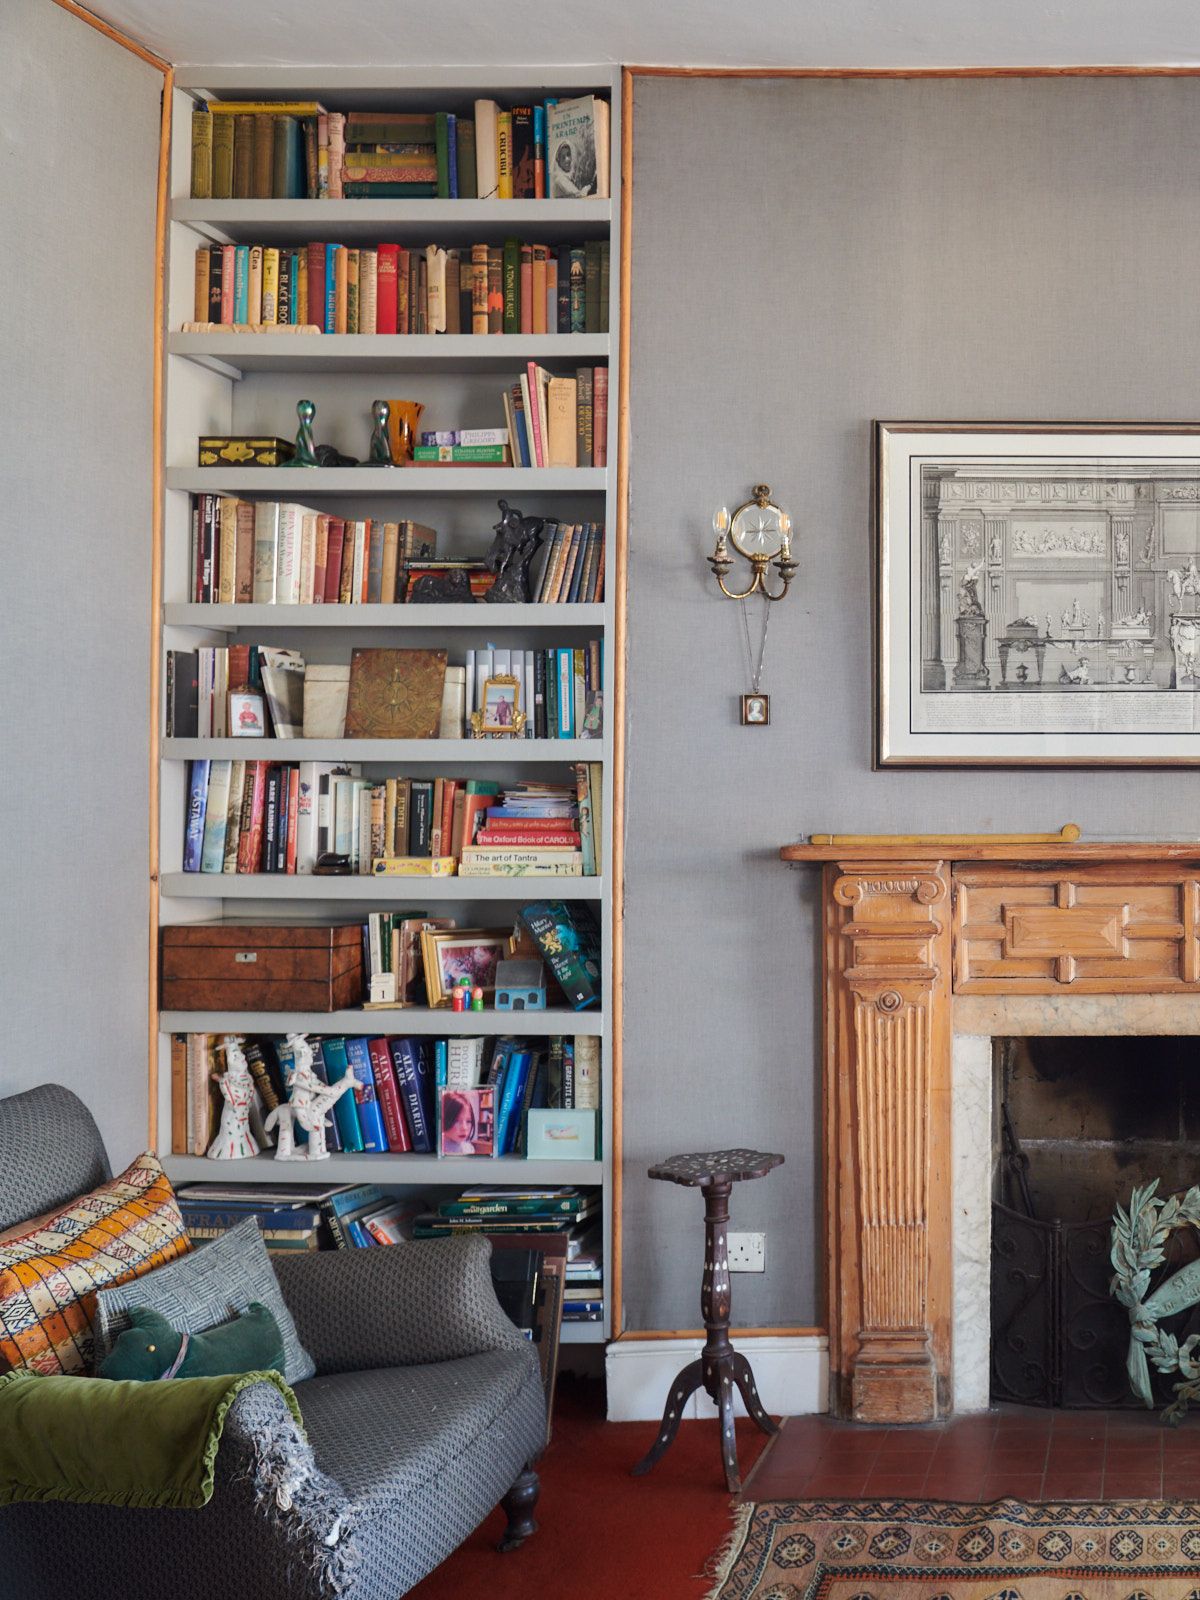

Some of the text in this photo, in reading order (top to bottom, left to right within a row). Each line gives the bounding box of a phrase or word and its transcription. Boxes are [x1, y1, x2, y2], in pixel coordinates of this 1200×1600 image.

[552, 115, 593, 131] PRINTEMPS
[499, 131, 508, 177] CRUCIBLE
[252, 249, 261, 271] Clea
[505, 270, 514, 290] TOWN
[279, 275, 288, 308] BLACK
[505, 291, 514, 303] LIKE
[279, 306, 288, 326] BOO
[505, 303, 514, 319] ALICE
[464, 431, 497, 439] PHILIPPA
[286, 510, 296, 551] RONALD
[189, 787, 202, 841] CASTAWAY
[266, 780, 276, 842] DARK RAINBOW
[397, 796, 406, 828] JUDITH
[480, 835, 574, 845] The Oxford Book of CAROLS
[475, 853, 538, 862] The art of Tantra
[422, 922, 437, 932] The
[533, 922, 553, 935] Mantel
[370, 1052, 384, 1087] CLARK
[379, 1054, 391, 1081] ALAN
[393, 1052, 408, 1087] CLARK
[402, 1054, 416, 1081] ALAN
[408, 1093, 425, 1137] DIARIES
[479, 1203, 508, 1214] garden
